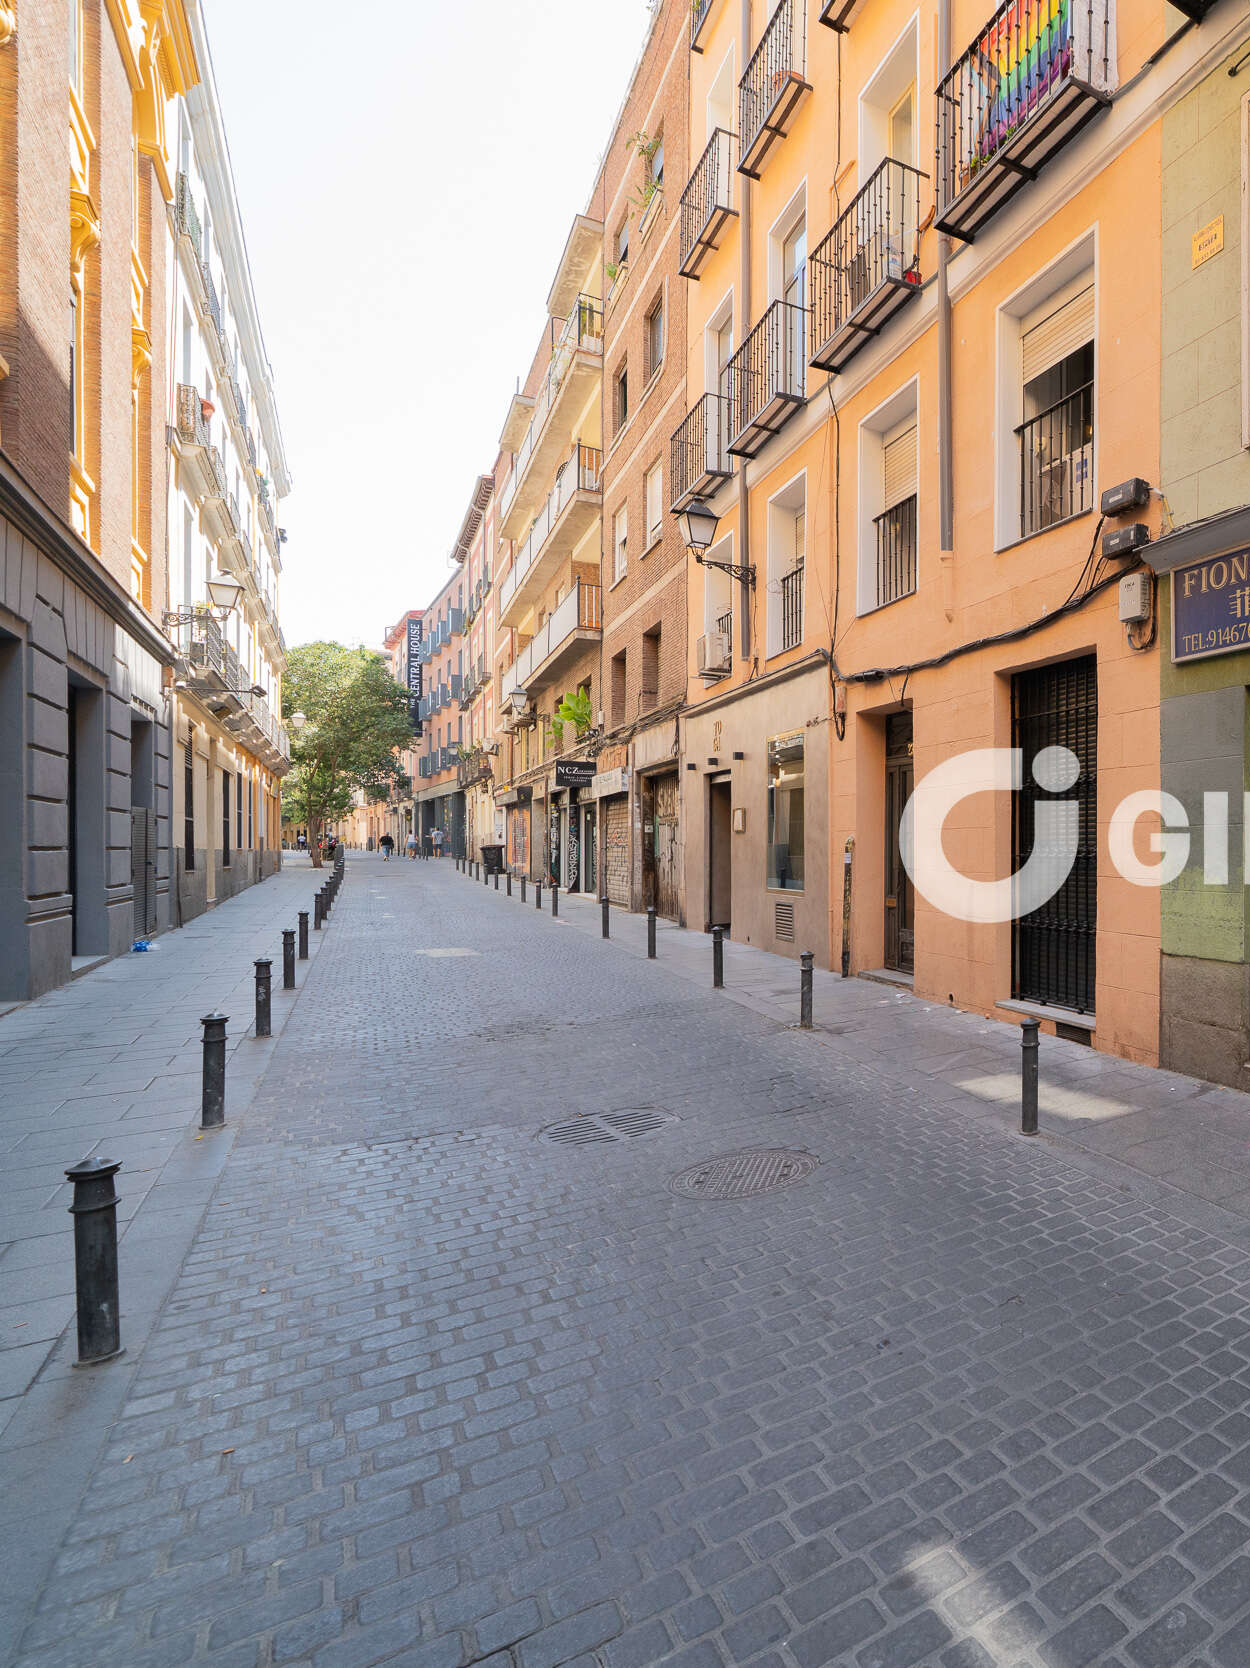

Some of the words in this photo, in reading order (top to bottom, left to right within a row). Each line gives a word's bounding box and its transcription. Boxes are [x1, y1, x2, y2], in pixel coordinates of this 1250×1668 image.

[410, 623, 420, 653] HOUSE
[410, 656, 420, 697] CENTRAL
[557, 766, 579, 775] NCZ
